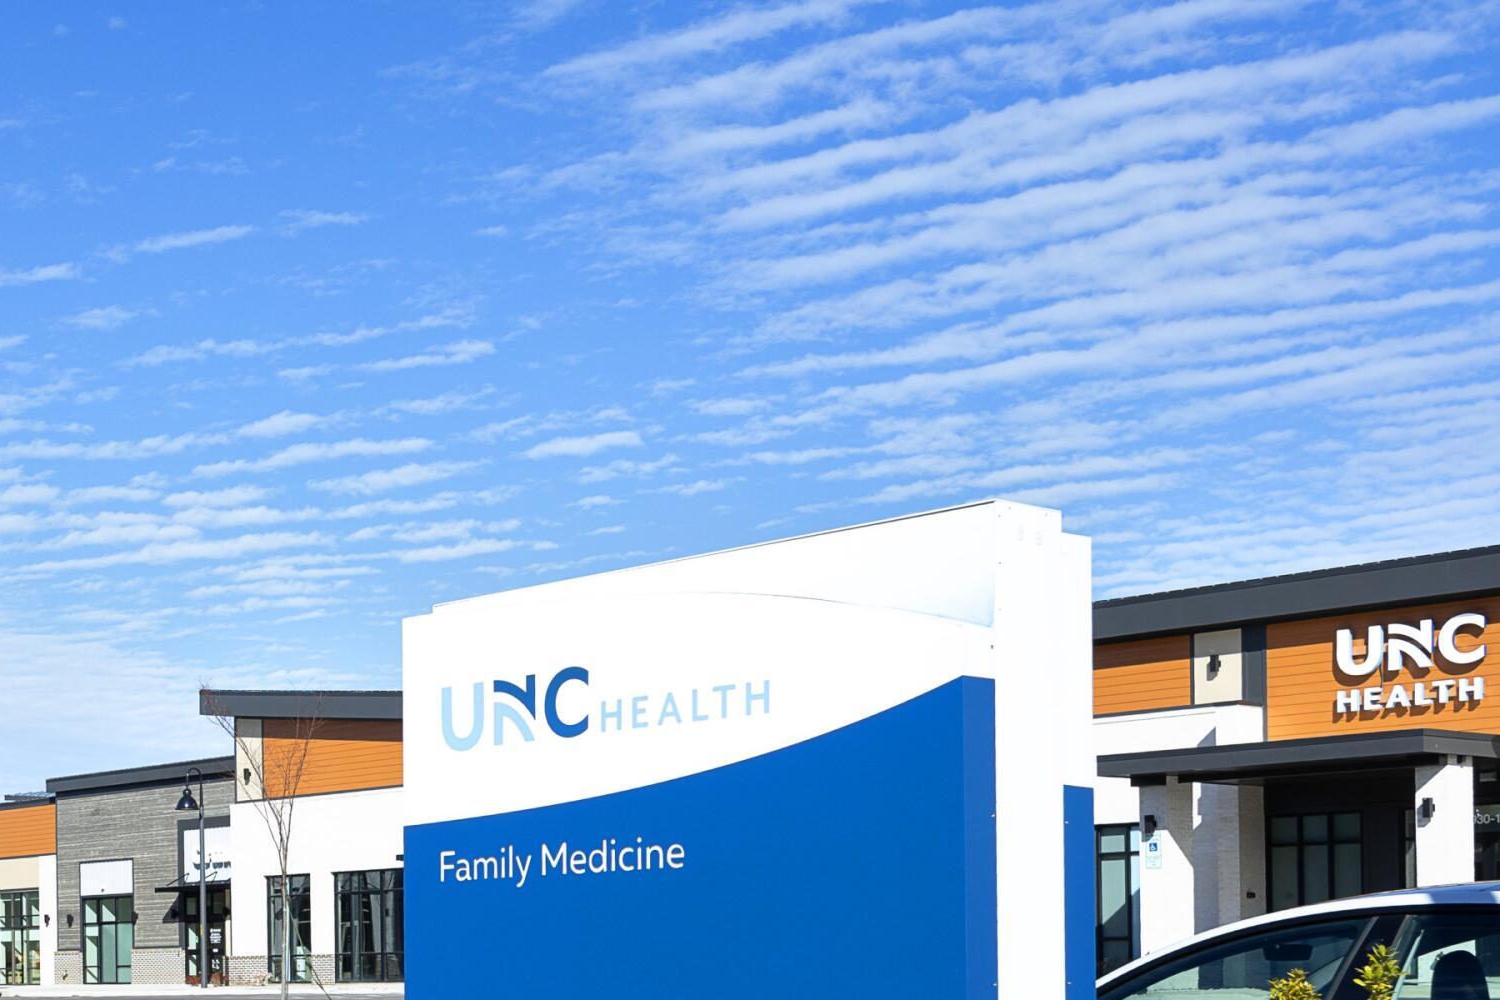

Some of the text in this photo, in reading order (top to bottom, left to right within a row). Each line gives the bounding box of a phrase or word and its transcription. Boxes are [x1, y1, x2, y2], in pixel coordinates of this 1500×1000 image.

[1336, 613, 1487, 676] UNC
[441, 666, 770, 752] UNC HEALTH
[1336, 677, 1484, 713] HEALTH
[440, 837, 685, 888] Family Medicine
